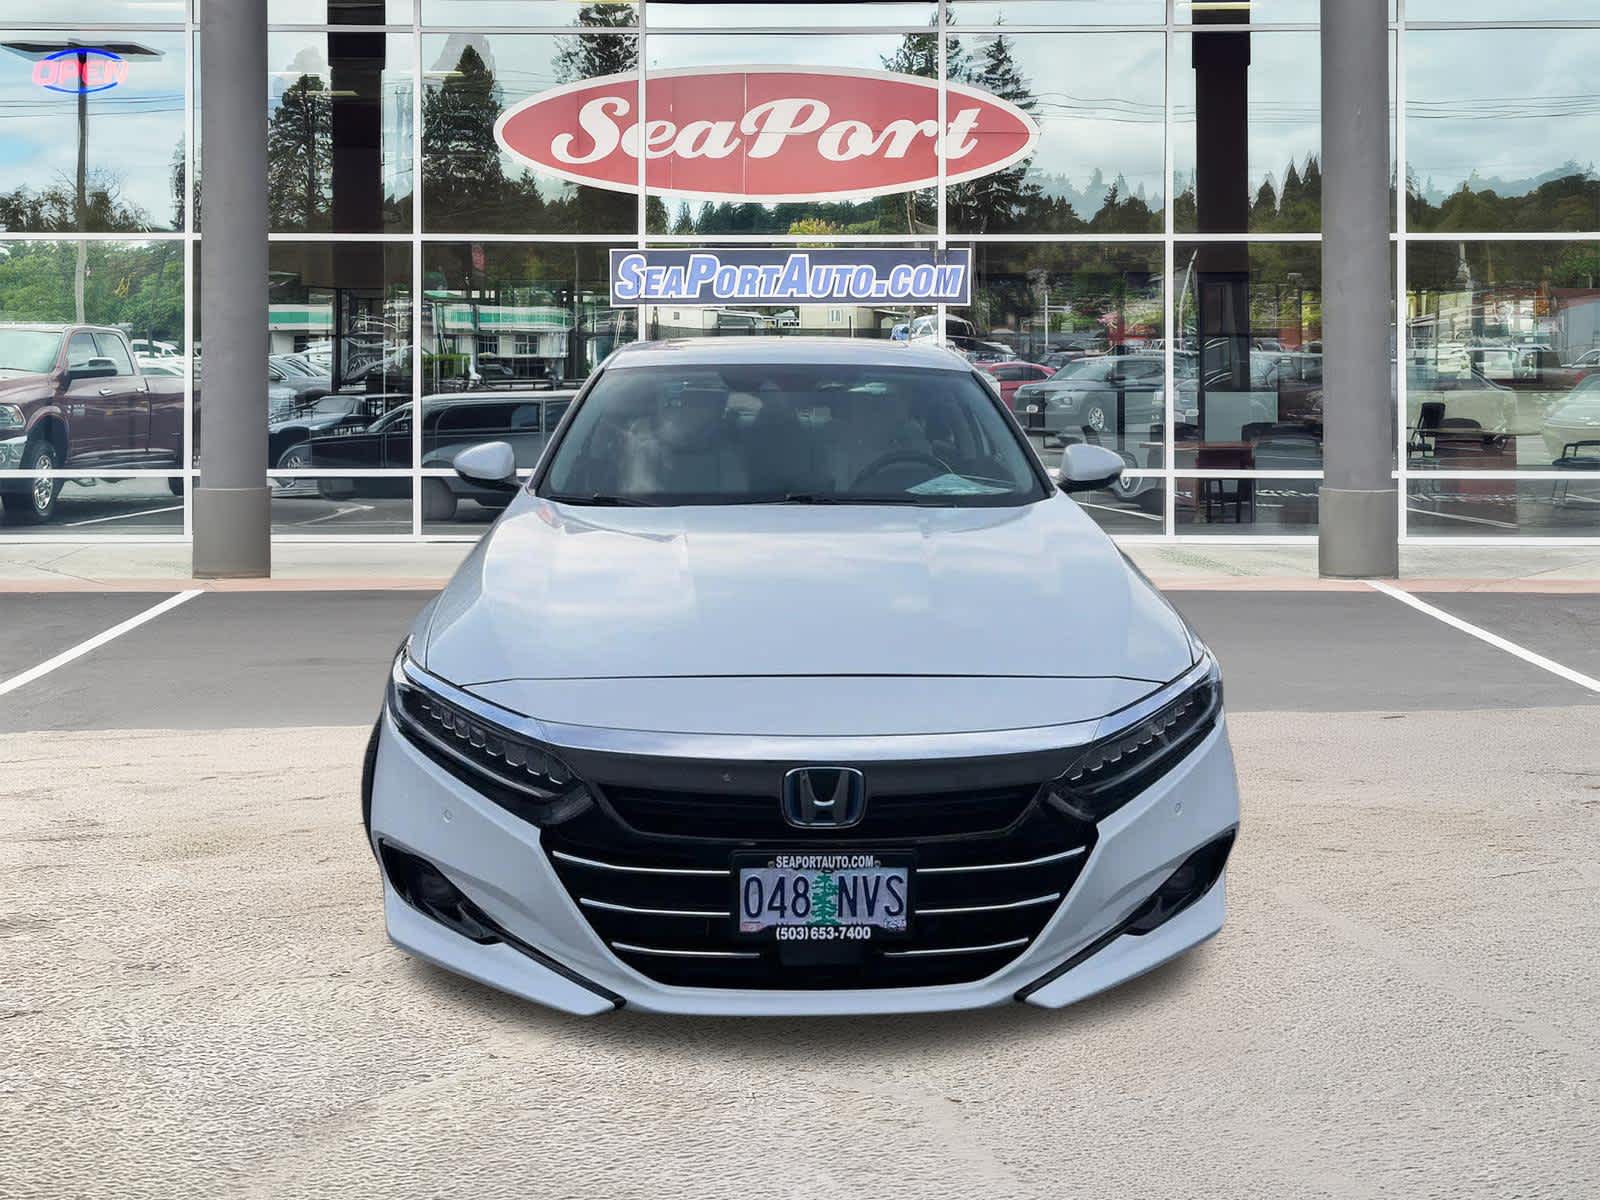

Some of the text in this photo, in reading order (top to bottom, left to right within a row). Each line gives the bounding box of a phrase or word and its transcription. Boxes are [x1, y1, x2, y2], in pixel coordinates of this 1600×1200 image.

[32, 60, 129, 86] OPEN
[550, 96, 981, 164] SeaPort
[775, 855, 874, 868] SEAPORTAUTO.COM
[744, 875, 904, 918] 048 NVS
[776, 926, 809, 940] (503)
[810, 926, 871, 940] 653-7400
